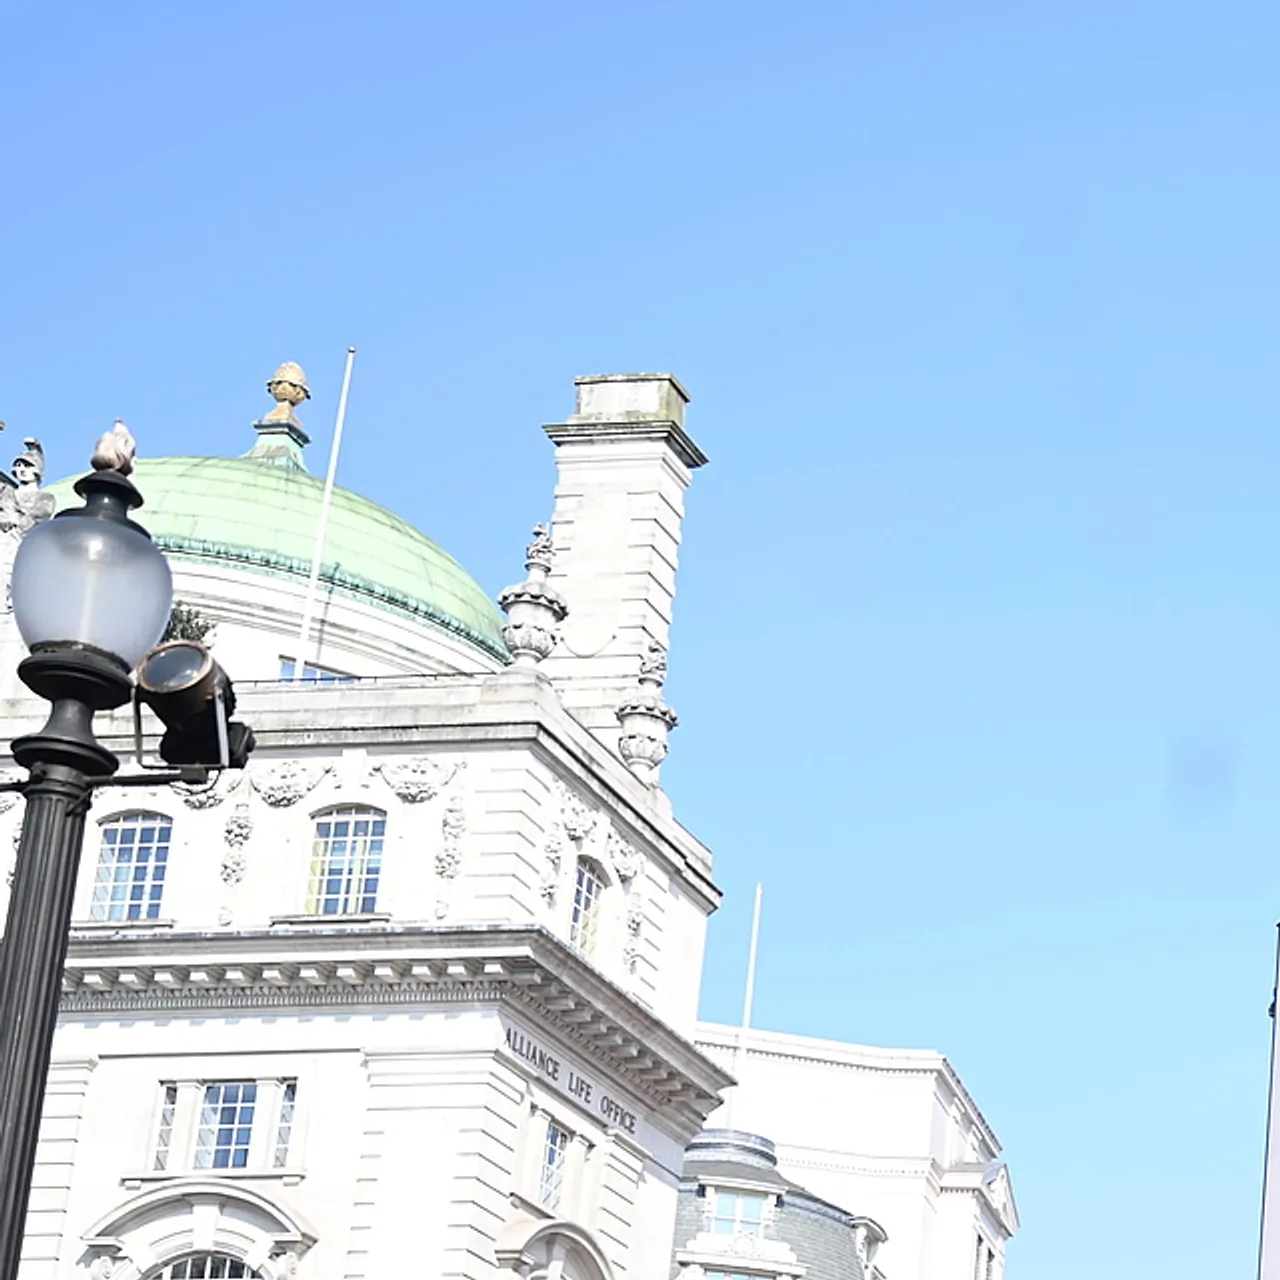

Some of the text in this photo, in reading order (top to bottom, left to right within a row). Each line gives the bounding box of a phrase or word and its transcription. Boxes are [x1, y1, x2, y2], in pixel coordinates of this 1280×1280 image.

[505, 1028, 637, 1134] ALLIANCE LIFE OFFICE
